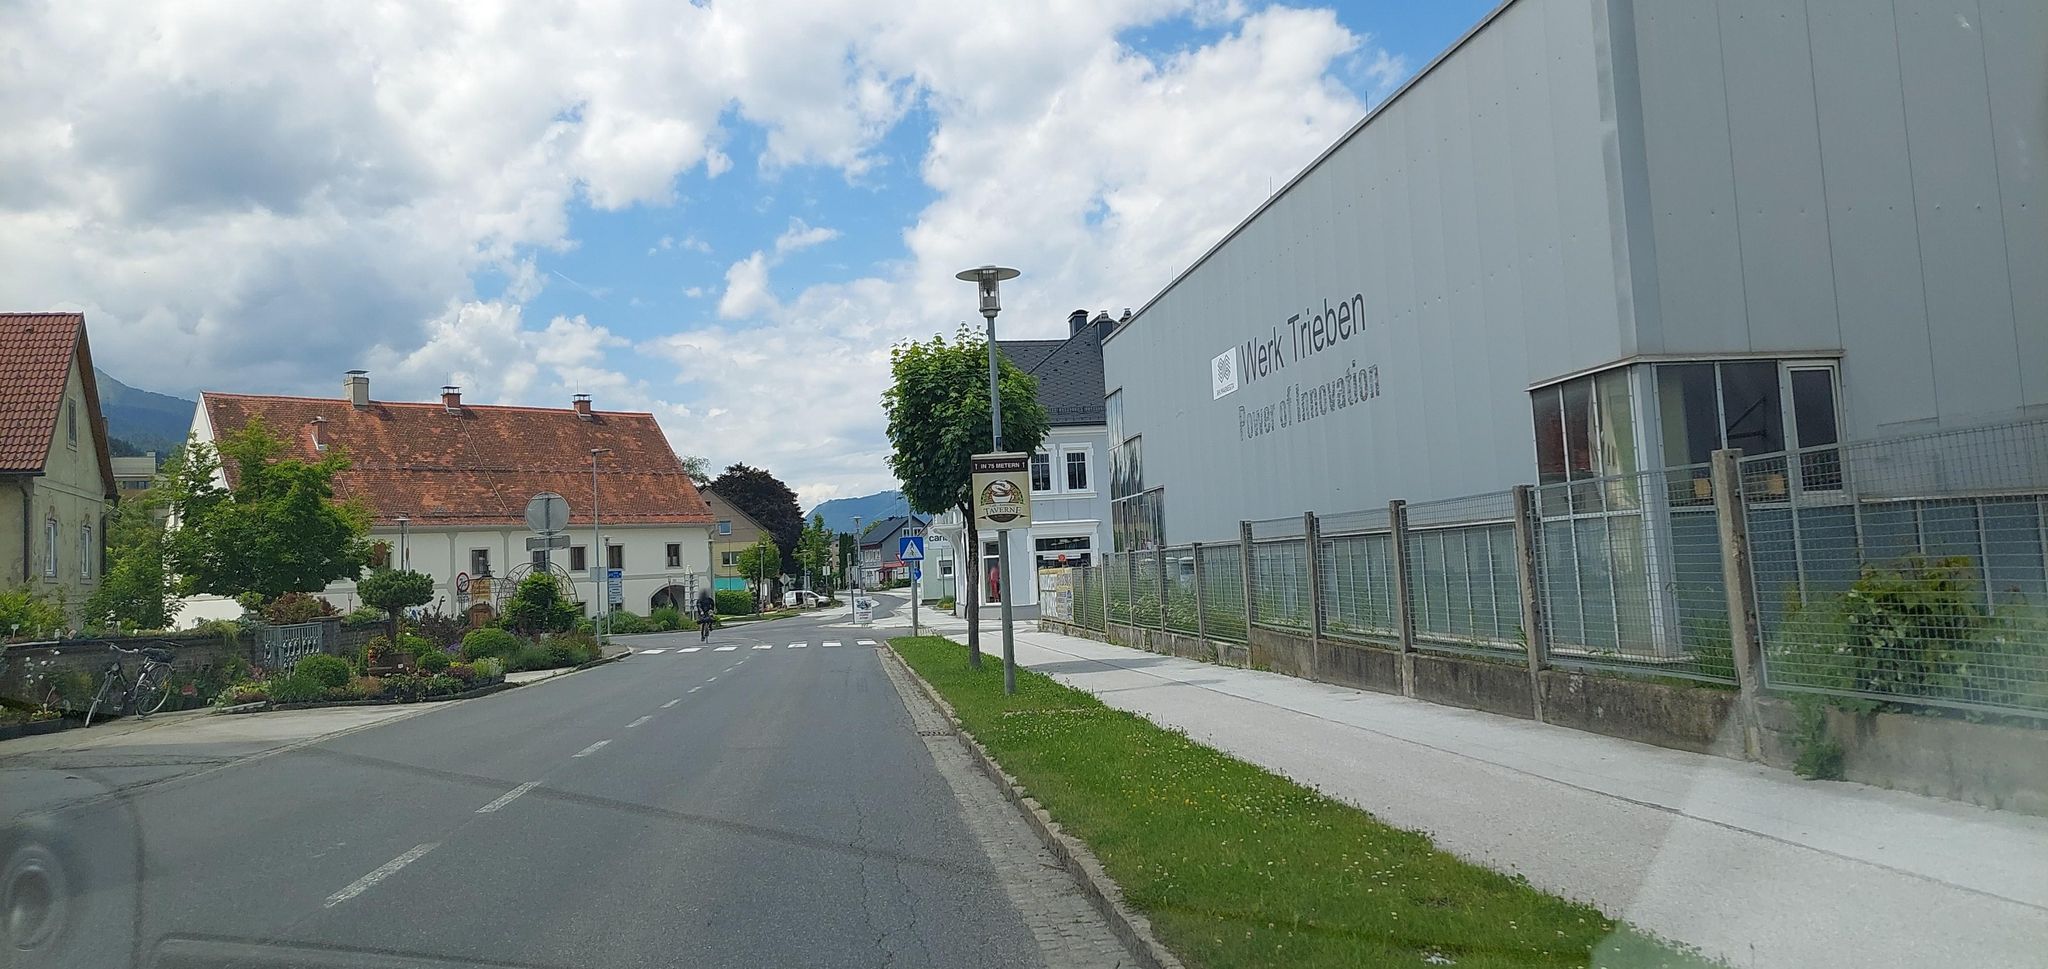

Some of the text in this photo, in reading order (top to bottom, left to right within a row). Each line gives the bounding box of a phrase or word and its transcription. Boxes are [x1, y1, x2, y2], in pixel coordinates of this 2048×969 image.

[1240, 292, 1366, 385] Werk Trieben
[1238, 359, 1381, 441] Power of Innovation
[983, 506, 1022, 515] TAVERNE
